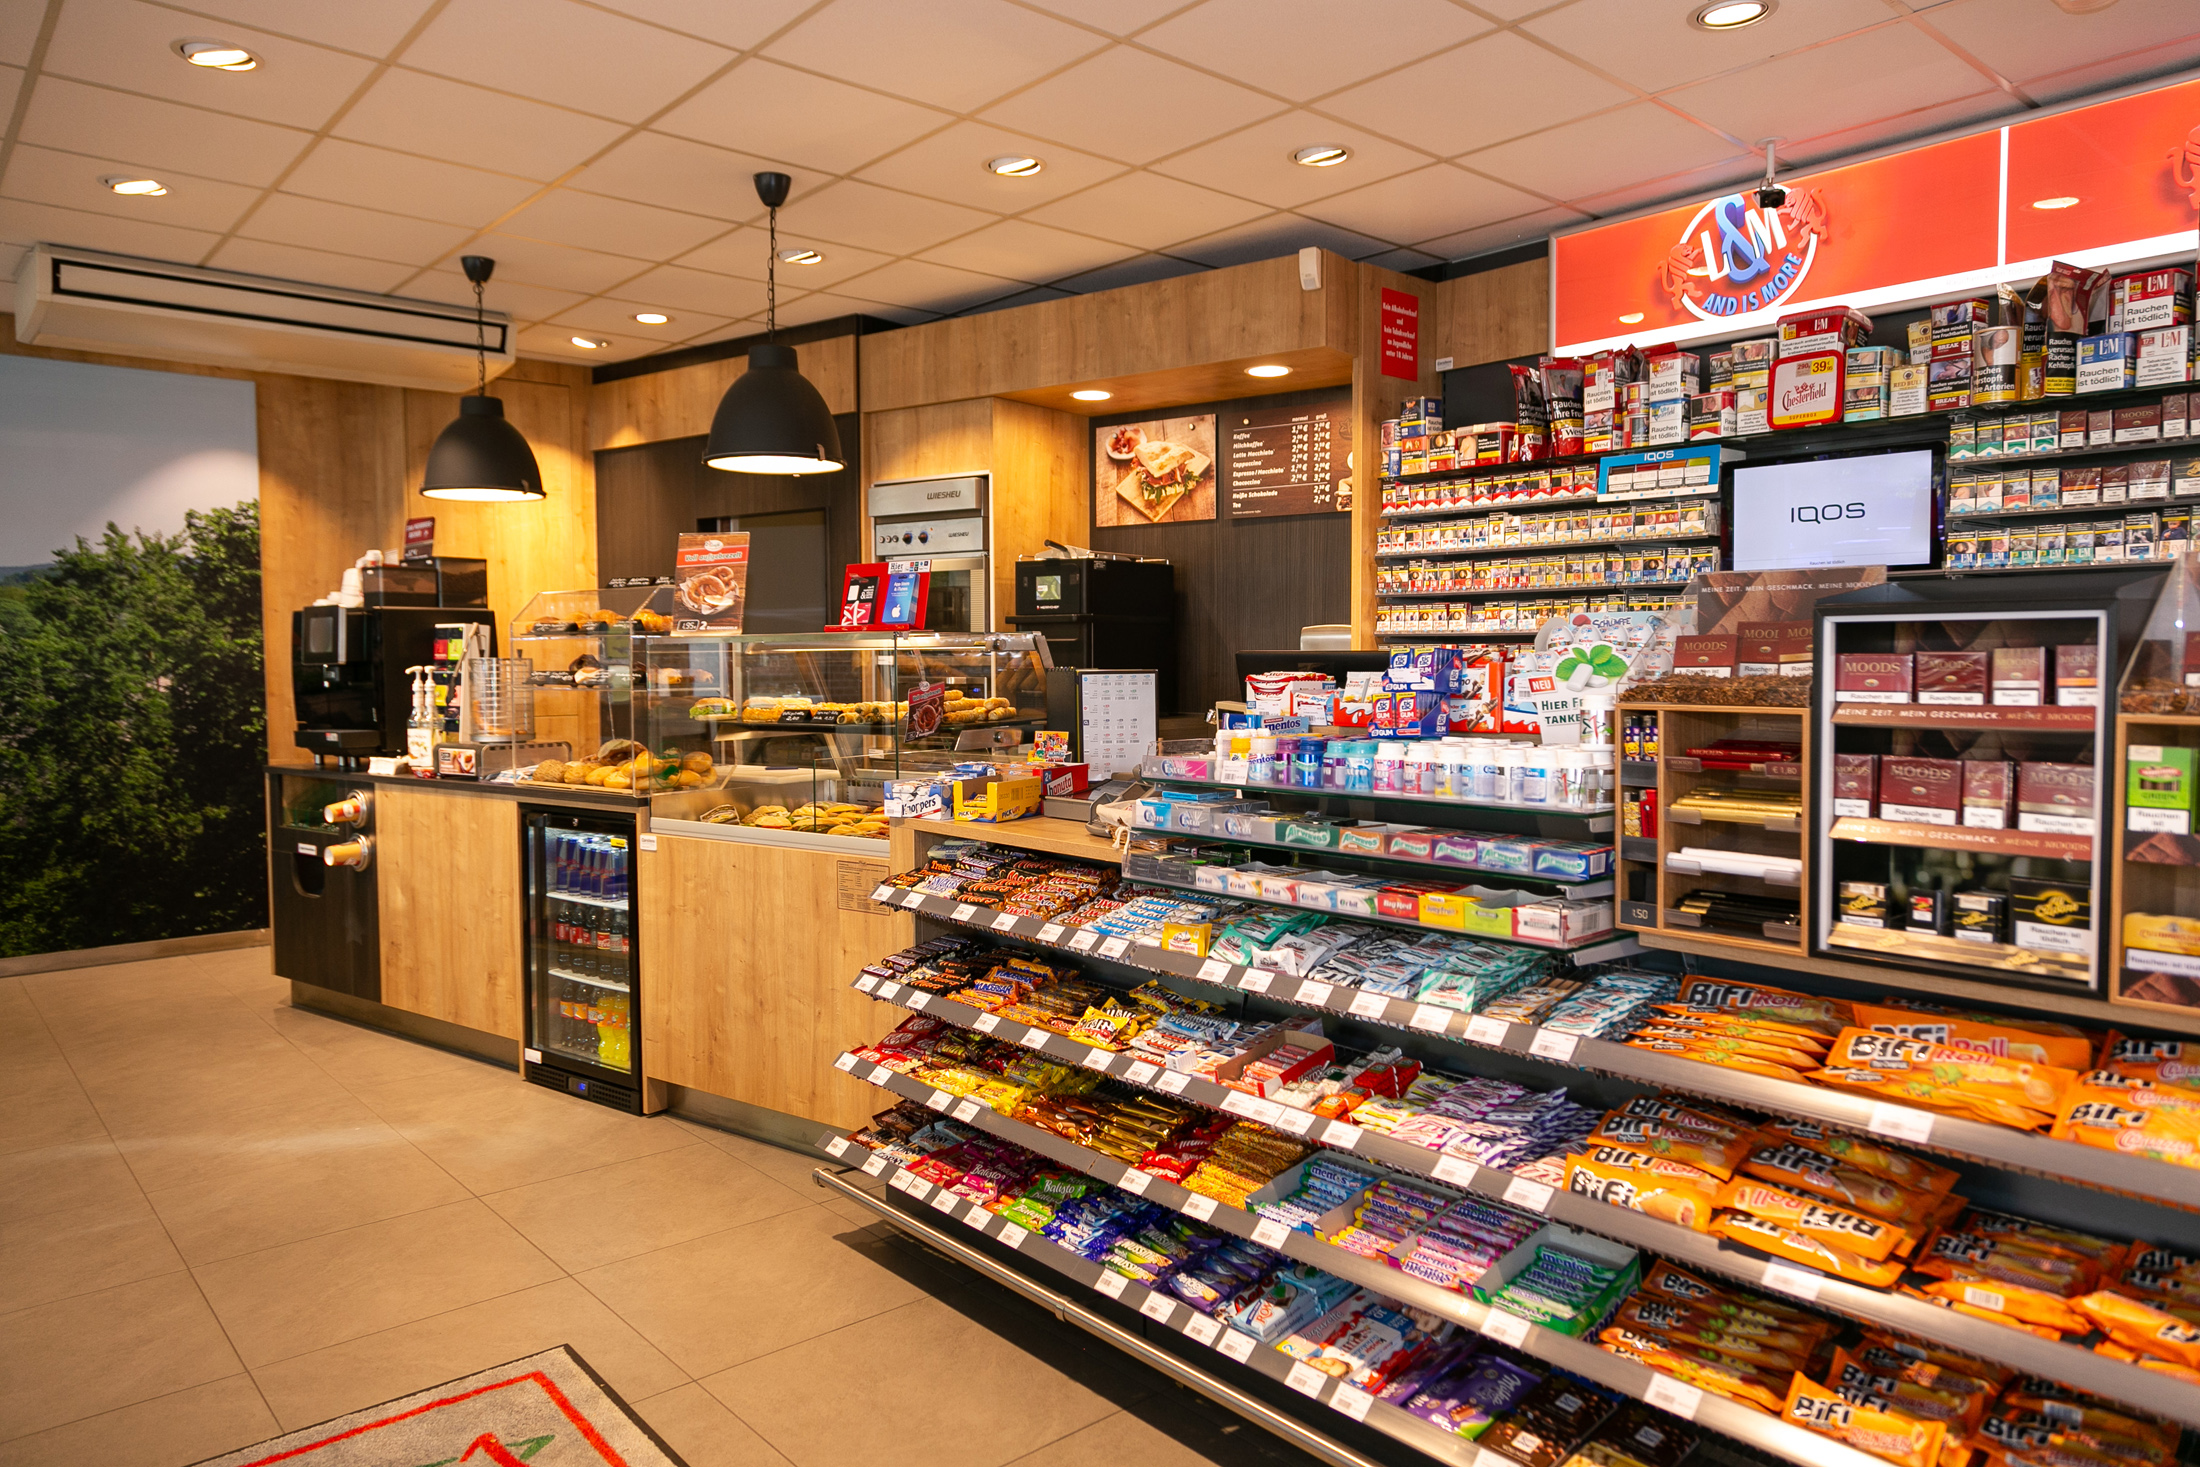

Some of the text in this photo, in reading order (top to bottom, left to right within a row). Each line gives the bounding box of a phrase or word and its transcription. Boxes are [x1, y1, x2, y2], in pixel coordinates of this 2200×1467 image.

[1700, 193, 1787, 283] L&M
[1702, 252, 1802, 316] AND IS MORE
[2147, 274, 2168, 292] L&M
[2127, 304, 2168, 316] Rauchen
[1814, 318, 1829, 332] L&M
[2125, 312, 2170, 325] ist tödlich
[2099, 338, 2119, 356] L&M
[2161, 331, 2181, 348] L&M
[1812, 361, 1826, 373] 39
[2080, 368, 2119, 378] Rauchen
[1650, 380, 1678, 390] Rauchen
[1984, 383, 2015, 391] Arterien
[2078, 375, 2121, 386] ist tödlich
[1658, 387, 1678, 396] tödlich
[1782, 384, 1826, 412] Chesterfield
[1595, 395, 1613, 404] tödlich
[2120, 410, 2154, 420] MOODS
[1651, 425, 1678, 434] Rauchen
[1659, 430, 1680, 440] tödlich
[1594, 441, 1610, 450] West
[1644, 450, 1674, 462] IQOS
[927, 490, 962, 500] WIESHEU
[1790, 502, 1866, 524] IQOS
[685, 552, 742, 562] Voll aufgebrezelt
[1766, 583, 1816, 591] GESCHMACK.
[700, 621, 707, 630] 2
[1684, 640, 1728, 652] MOODS
[1845, 662, 1900, 673] MOODS
[1928, 660, 1975, 671] MOODS
[1532, 679, 1550, 691] NEU
[1542, 700, 1568, 711] HIER
[1928, 694, 1962, 702] Rauchen
[1837, 708, 1868, 716] MEINE
[1899, 710, 1926, 718] MEIN
[1930, 710, 2002, 720] GESCHMACK.
[2046, 712, 2093, 721] MOODS
[1264, 718, 1301, 731] mentos
[1378, 728, 1394, 736] GUM
[1692, 748, 1724, 758] MOODS
[1780, 766, 1797, 775] 1,80
[1890, 764, 1952, 780] MOODS
[2030, 771, 2095, 786] MOODS
[1895, 808, 1930, 816] Rauchen
[1285, 824, 1331, 847] Airwaves
[1342, 832, 1380, 850] Airwaves
[1898, 828, 1925, 838] MEIN
[1928, 830, 2000, 844] GESCHMACK.
[2004, 838, 2040, 848] MEINE
[1390, 838, 1430, 857] Airwaves
[1434, 842, 1476, 862] Airwaves
[1482, 848, 1525, 868] Airwaves
[1536, 852, 1586, 875] Airwaves
[930, 860, 952, 873] Treets
[1005, 904, 1032, 917] TWIX
[975, 981, 1014, 994] WUNDERBAR
[1690, 982, 1752, 1008] BiFi
[1754, 992, 1802, 1008] Roll
[1849, 1034, 1934, 1061] BiFi
[1934, 1050, 1992, 1065] Roll
[1625, 1098, 1680, 1120] BiFi
[2068, 1102, 2150, 1127] BiFi
[1601, 1116, 1662, 1136] BiFi
[1593, 1146, 1657, 1166] BiFi
[972, 1164, 1002, 1181] Balisto
[1311, 1166, 1348, 1186] mentos
[1044, 1179, 1076, 1196] Balisto
[1570, 1164, 1637, 1208] BiFi
[1371, 1199, 1412, 1219] mentos
[1354, 1228, 1378, 1242] mentos
[1427, 1229, 1475, 1250] mentos
[1412, 1250, 1458, 1273] mentos
[1542, 1252, 1594, 1275] mentos
[1540, 1260, 1591, 1283] mentos
[1301, 1310, 1345, 1345] Yogurette
[1840, 1362, 1898, 1395] BiFi
[1492, 1373, 1522, 1406] Milka
[1794, 1396, 1852, 1425] BiFi
